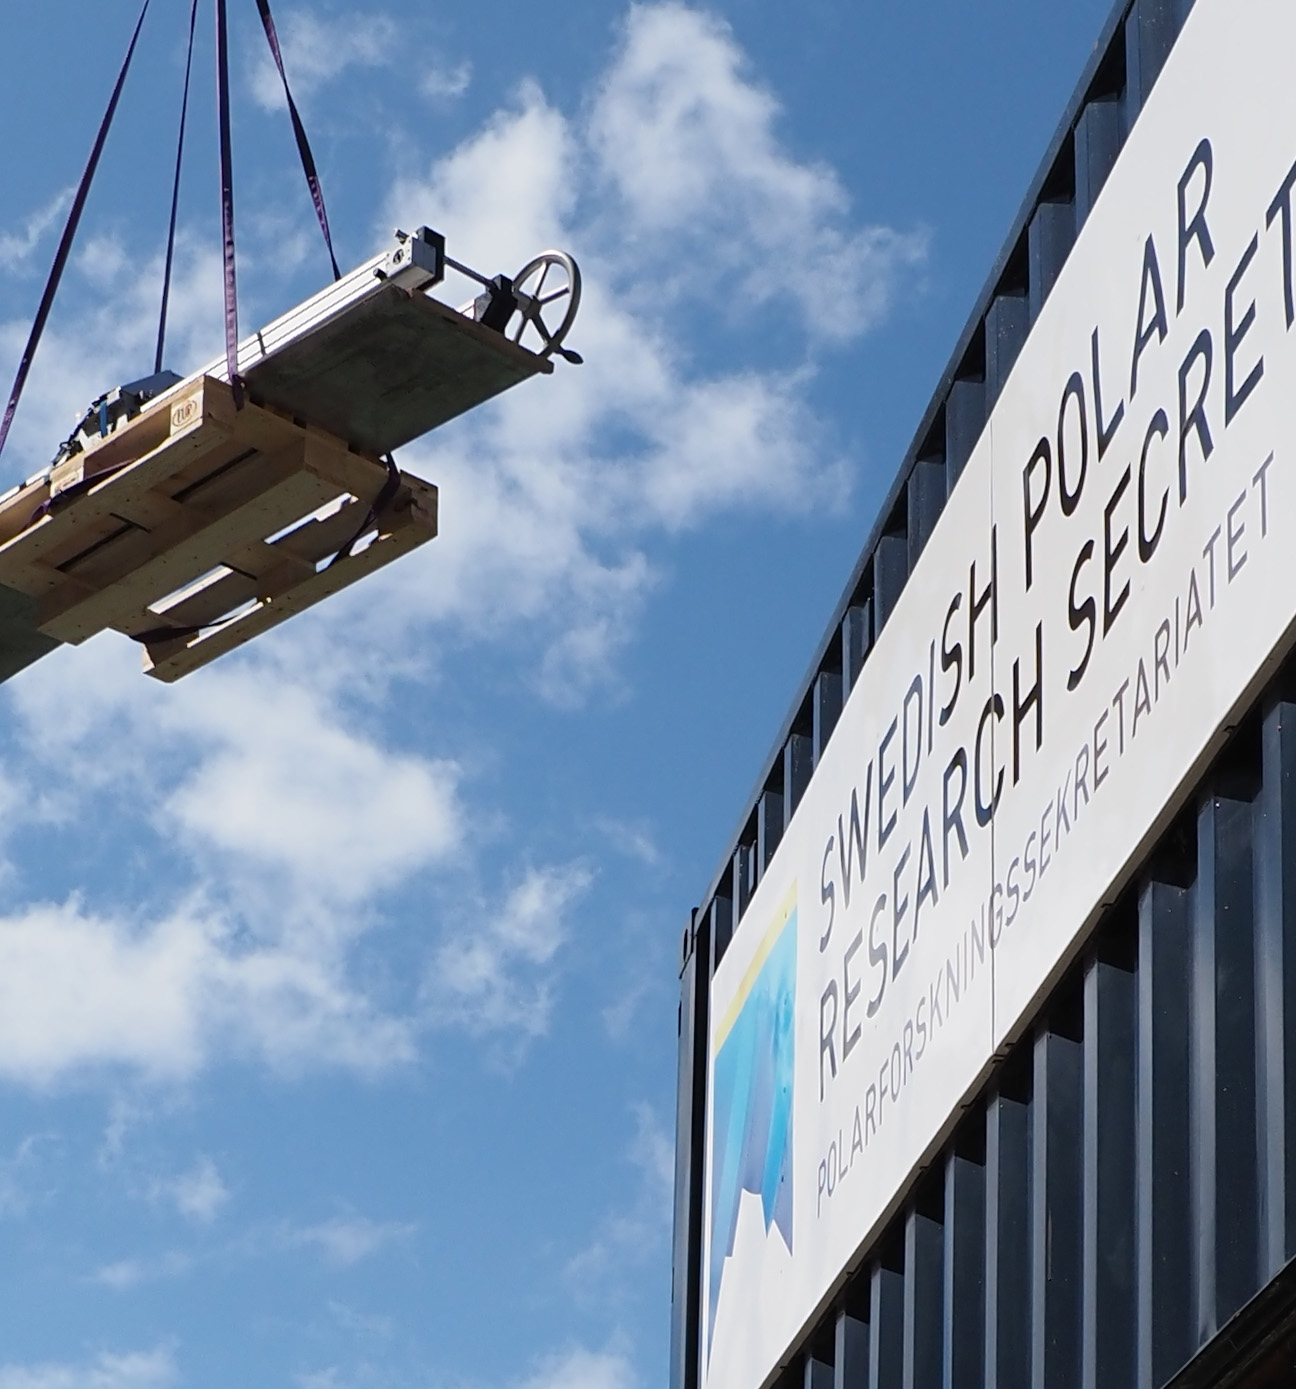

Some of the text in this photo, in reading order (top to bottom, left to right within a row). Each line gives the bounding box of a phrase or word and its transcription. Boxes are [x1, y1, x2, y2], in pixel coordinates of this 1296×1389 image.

[815, 450, 1275, 1219] POLARFORSKNINGSSEKRETARIATET
[818, 138, 1216, 953] SWEDISH POLAR
[818, 619, 1043, 1103] RESEARCH
